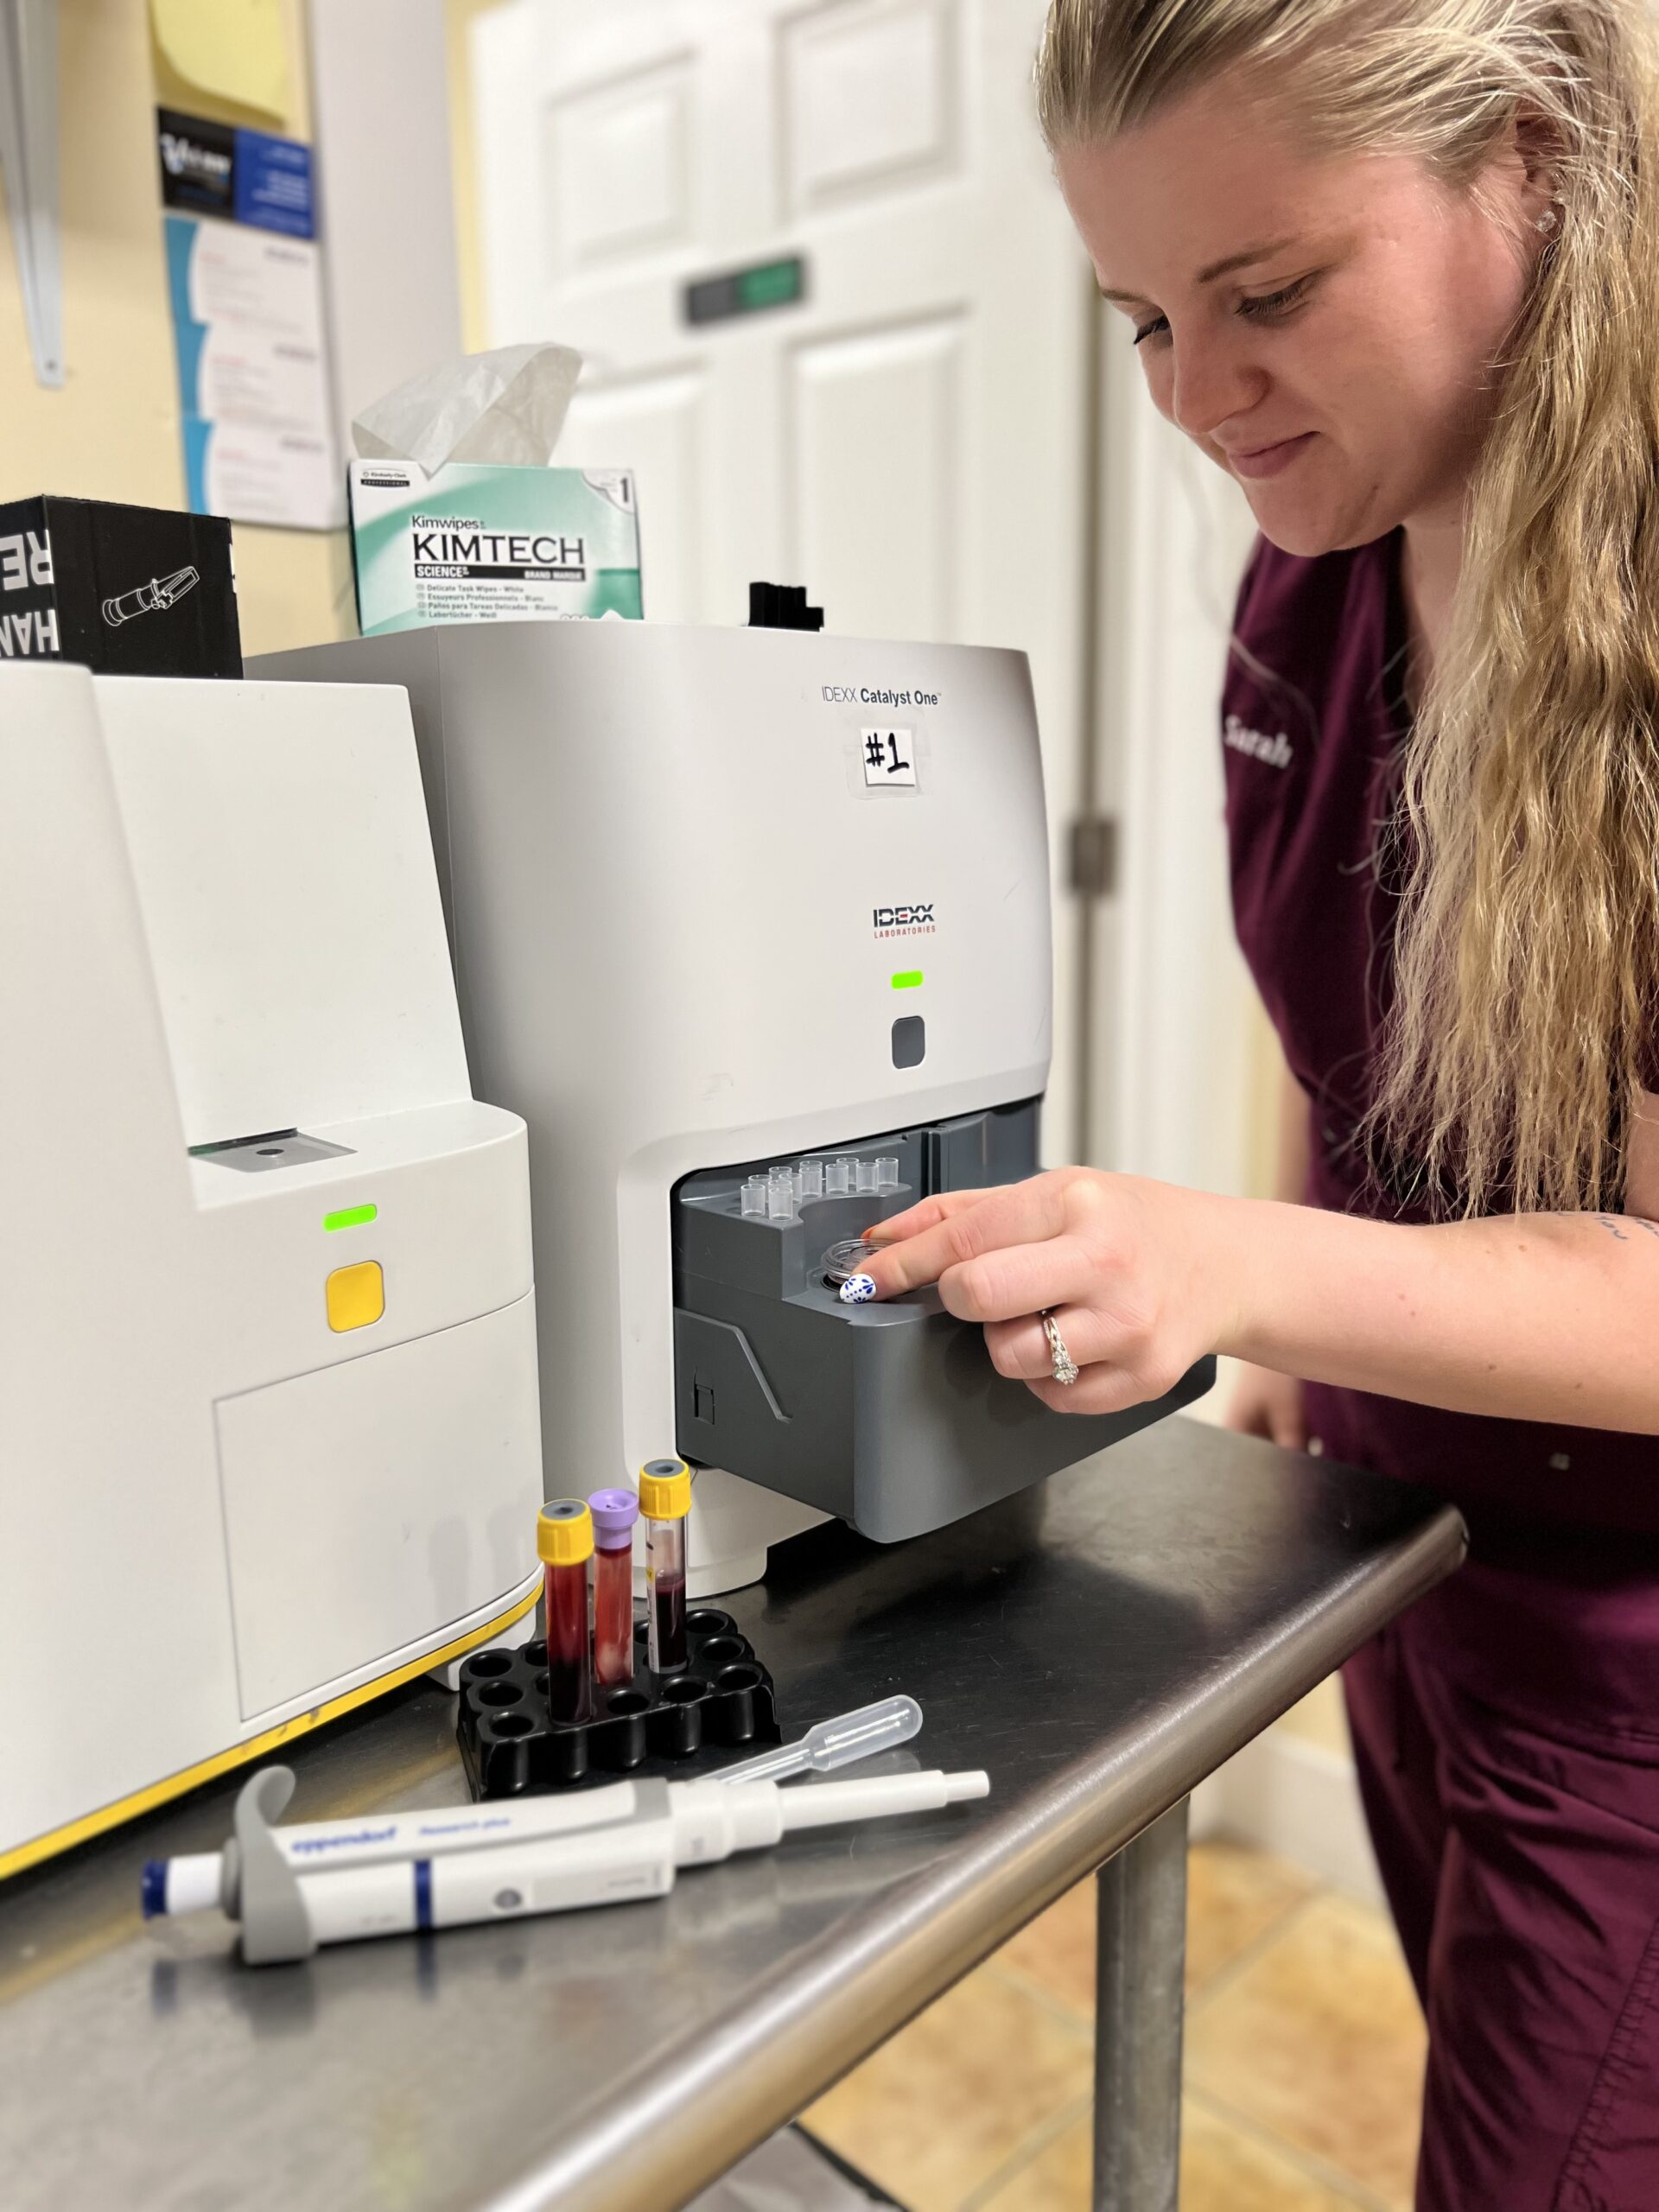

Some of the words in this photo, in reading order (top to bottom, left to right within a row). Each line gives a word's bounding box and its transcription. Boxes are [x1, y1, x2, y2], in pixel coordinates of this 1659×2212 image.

[620, 477, 629, 503] 1
[412, 516, 479, 531] Kimwipes
[412, 533, 585, 564] KIMTECH
[416, 566, 464, 578] SCIENCE
[427, 593, 465, 601] Essuyeurs
[822, 686, 857, 703] IDEXX
[860, 688, 912, 708] Catalyst
[914, 690, 938, 705] One
[865, 732, 910, 774] #1
[1224, 715, 1294, 768] Sarah
[873, 904, 935, 928] IDEXX
[874, 925, 936, 939] LABORATORIES
[291, 1826, 397, 1853] eppendorf
